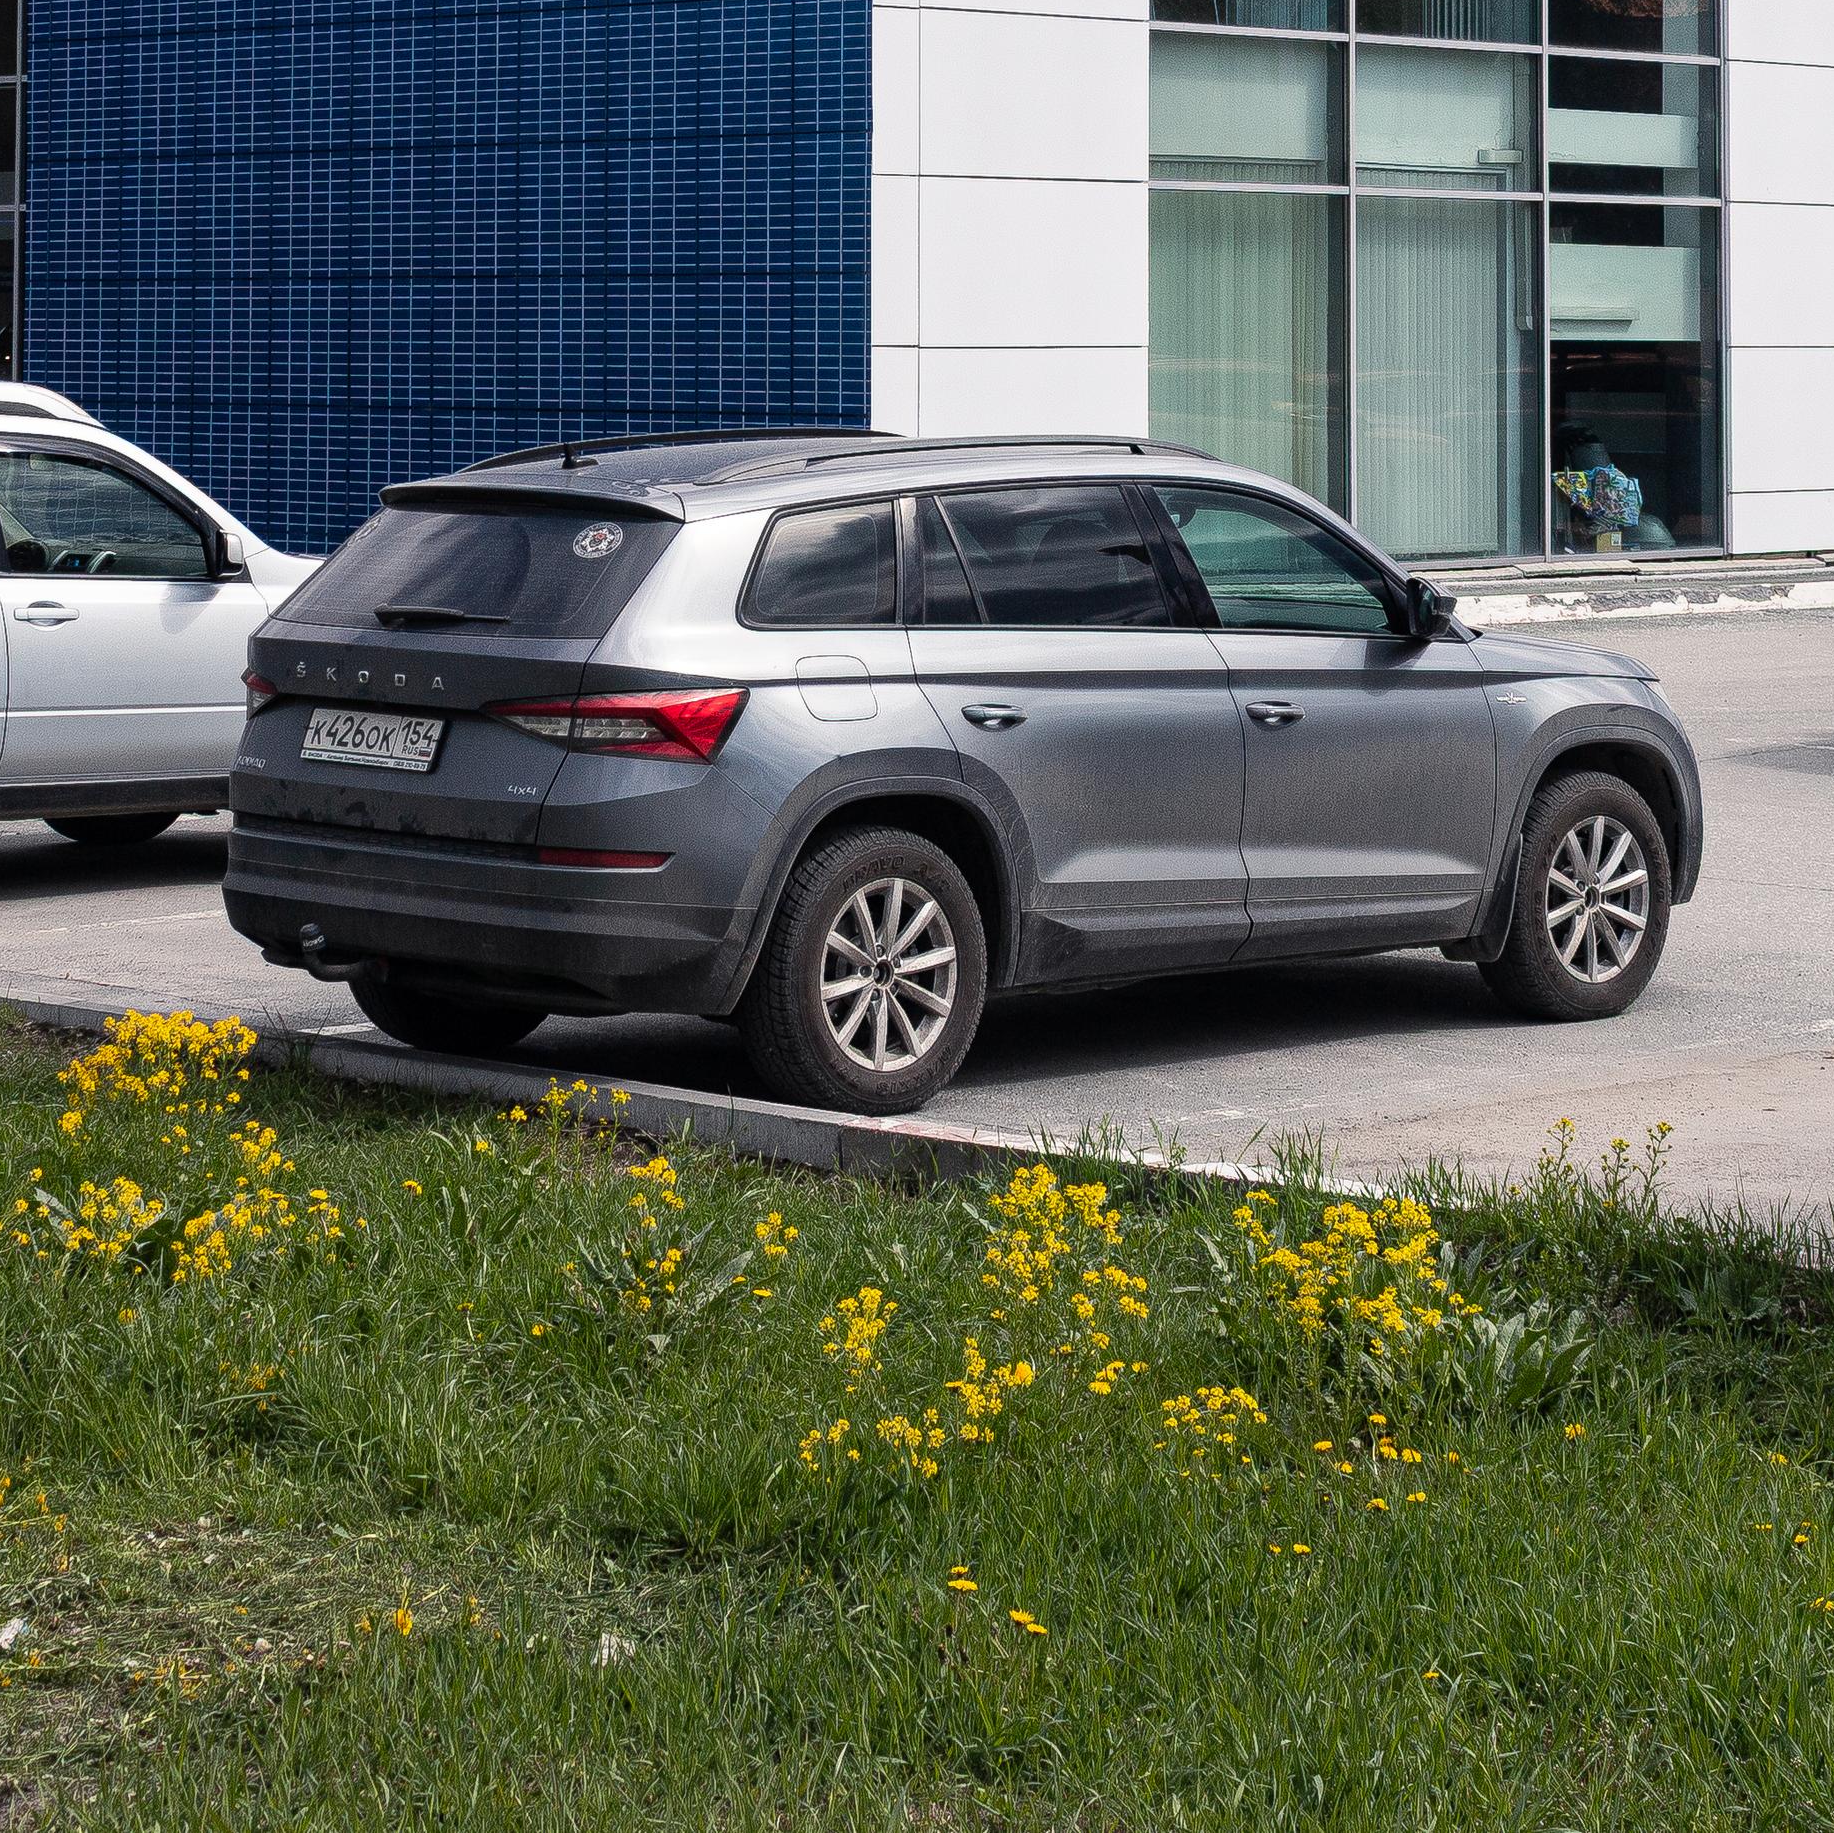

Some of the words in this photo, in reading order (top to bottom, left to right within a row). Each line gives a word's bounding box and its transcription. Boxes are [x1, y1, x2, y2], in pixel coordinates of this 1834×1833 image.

[296, 661, 445, 691] ŠKODA
[308, 713, 399, 754] К426ОК
[401, 719, 435, 747] 154
[401, 744, 419, 756] RUS
